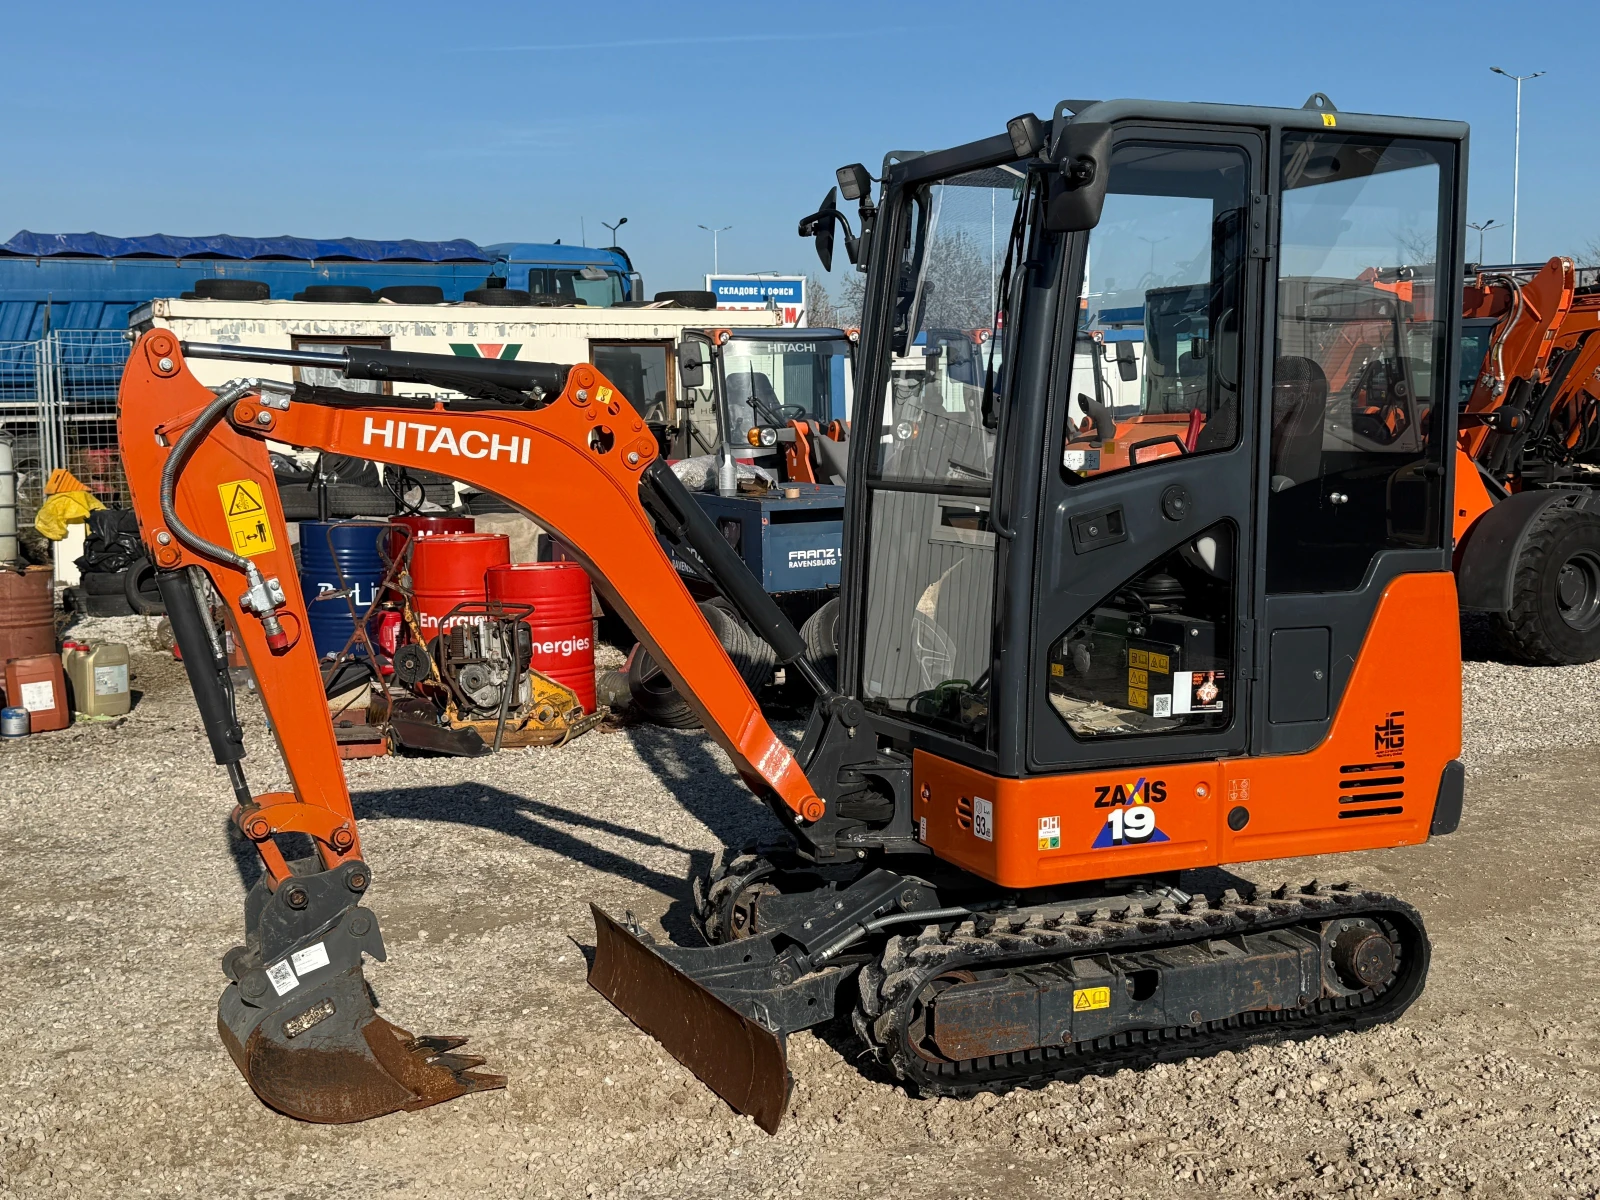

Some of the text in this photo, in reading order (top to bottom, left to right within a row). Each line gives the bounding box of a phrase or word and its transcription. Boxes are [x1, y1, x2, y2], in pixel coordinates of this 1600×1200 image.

[718, 286, 759, 296] СКЛАДОВЕ
[767, 287, 794, 296] ОФИСИ
[767, 343, 816, 353] HITACHI
[362, 416, 532, 465] HITACHI
[788, 548, 835, 560] FRANZ
[788, 558, 837, 569] RAVENSBURG
[532, 635, 590, 657] nergies
[1094, 777, 1168, 809] ZAXIS
[975, 814, 986, 836] 93
[1107, 806, 1156, 843] 19
